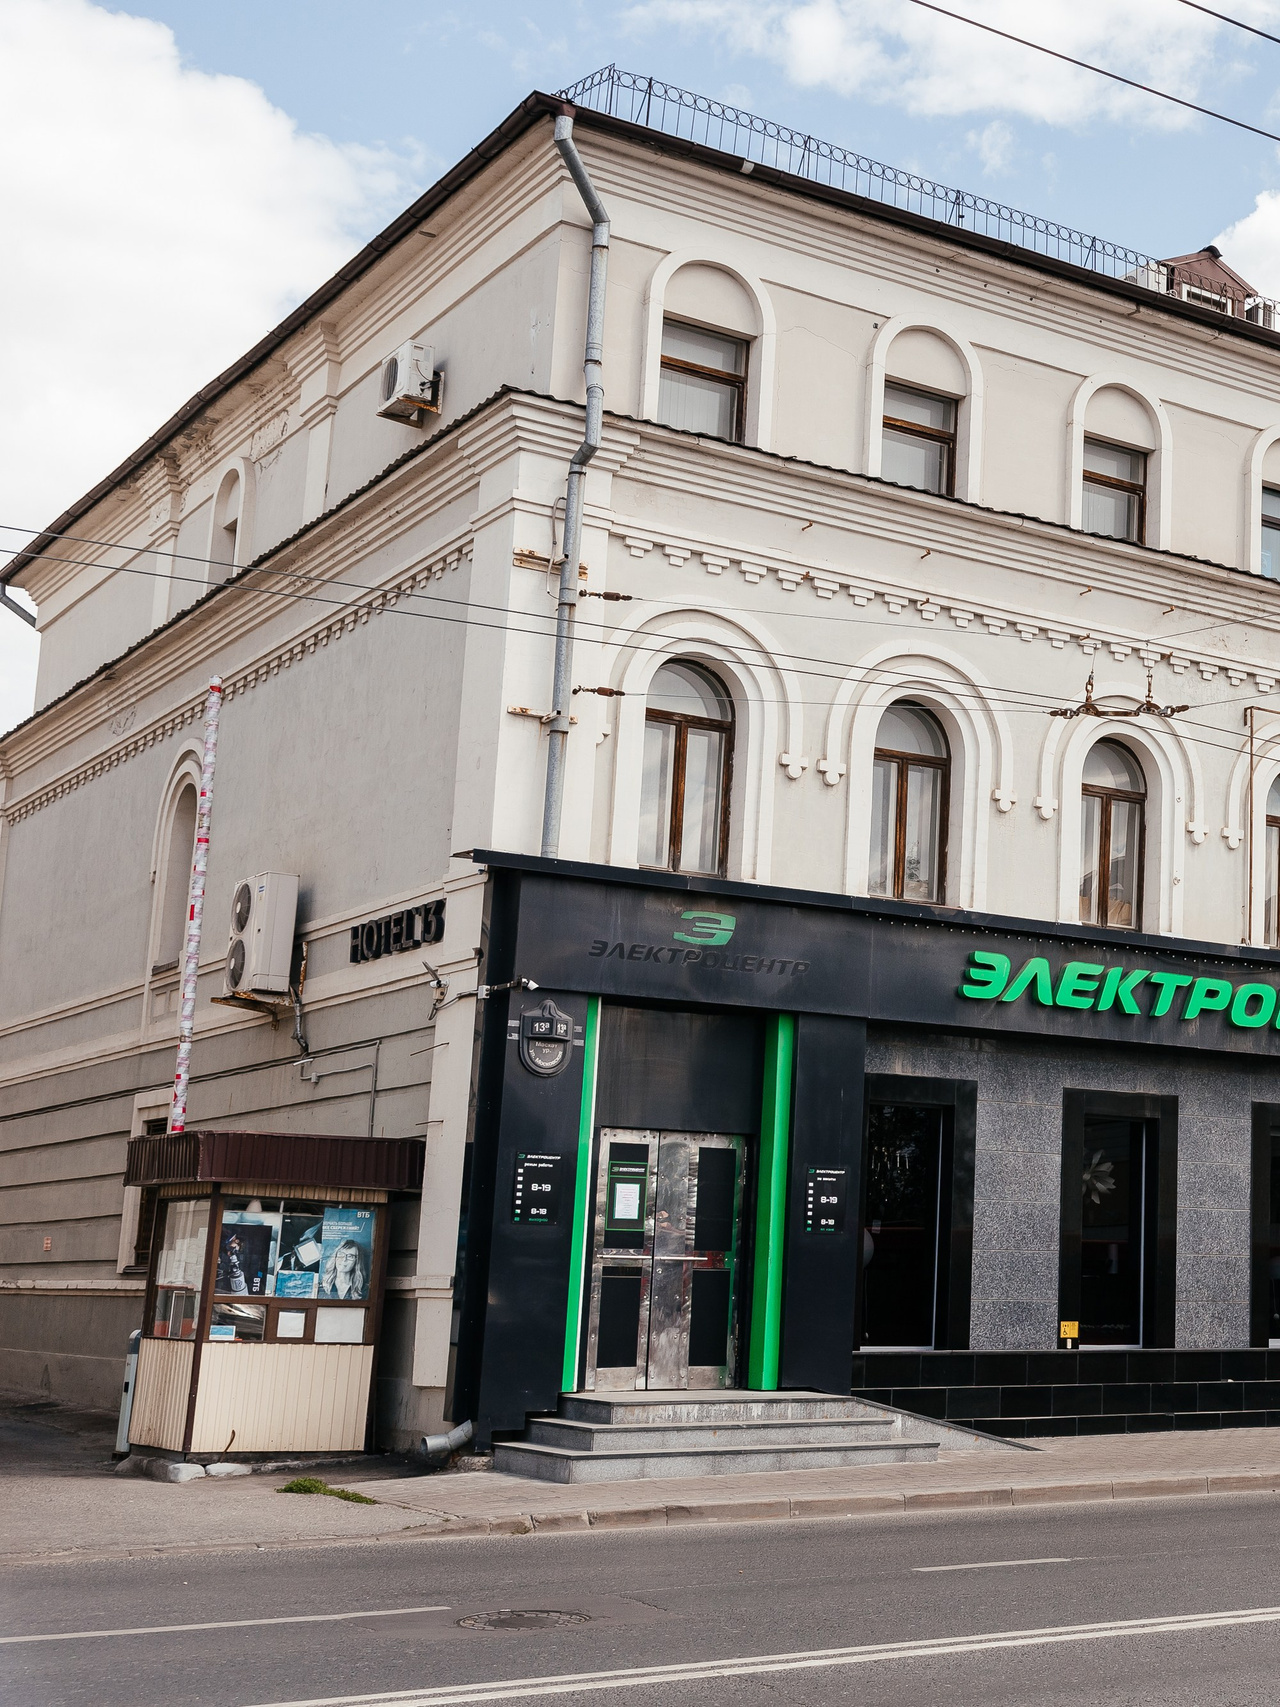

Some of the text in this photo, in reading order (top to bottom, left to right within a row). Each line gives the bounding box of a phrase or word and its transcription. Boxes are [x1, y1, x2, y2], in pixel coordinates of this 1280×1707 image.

[588, 939, 811, 977] ЭЛЕКТРОЦЕНТР
[531, 1183, 552, 1192] 8-19
[820, 1195, 838, 1204] 8-19
[356, 1211, 371, 1219] ВТБ
[252, 1277, 261, 1292] ВТБ
